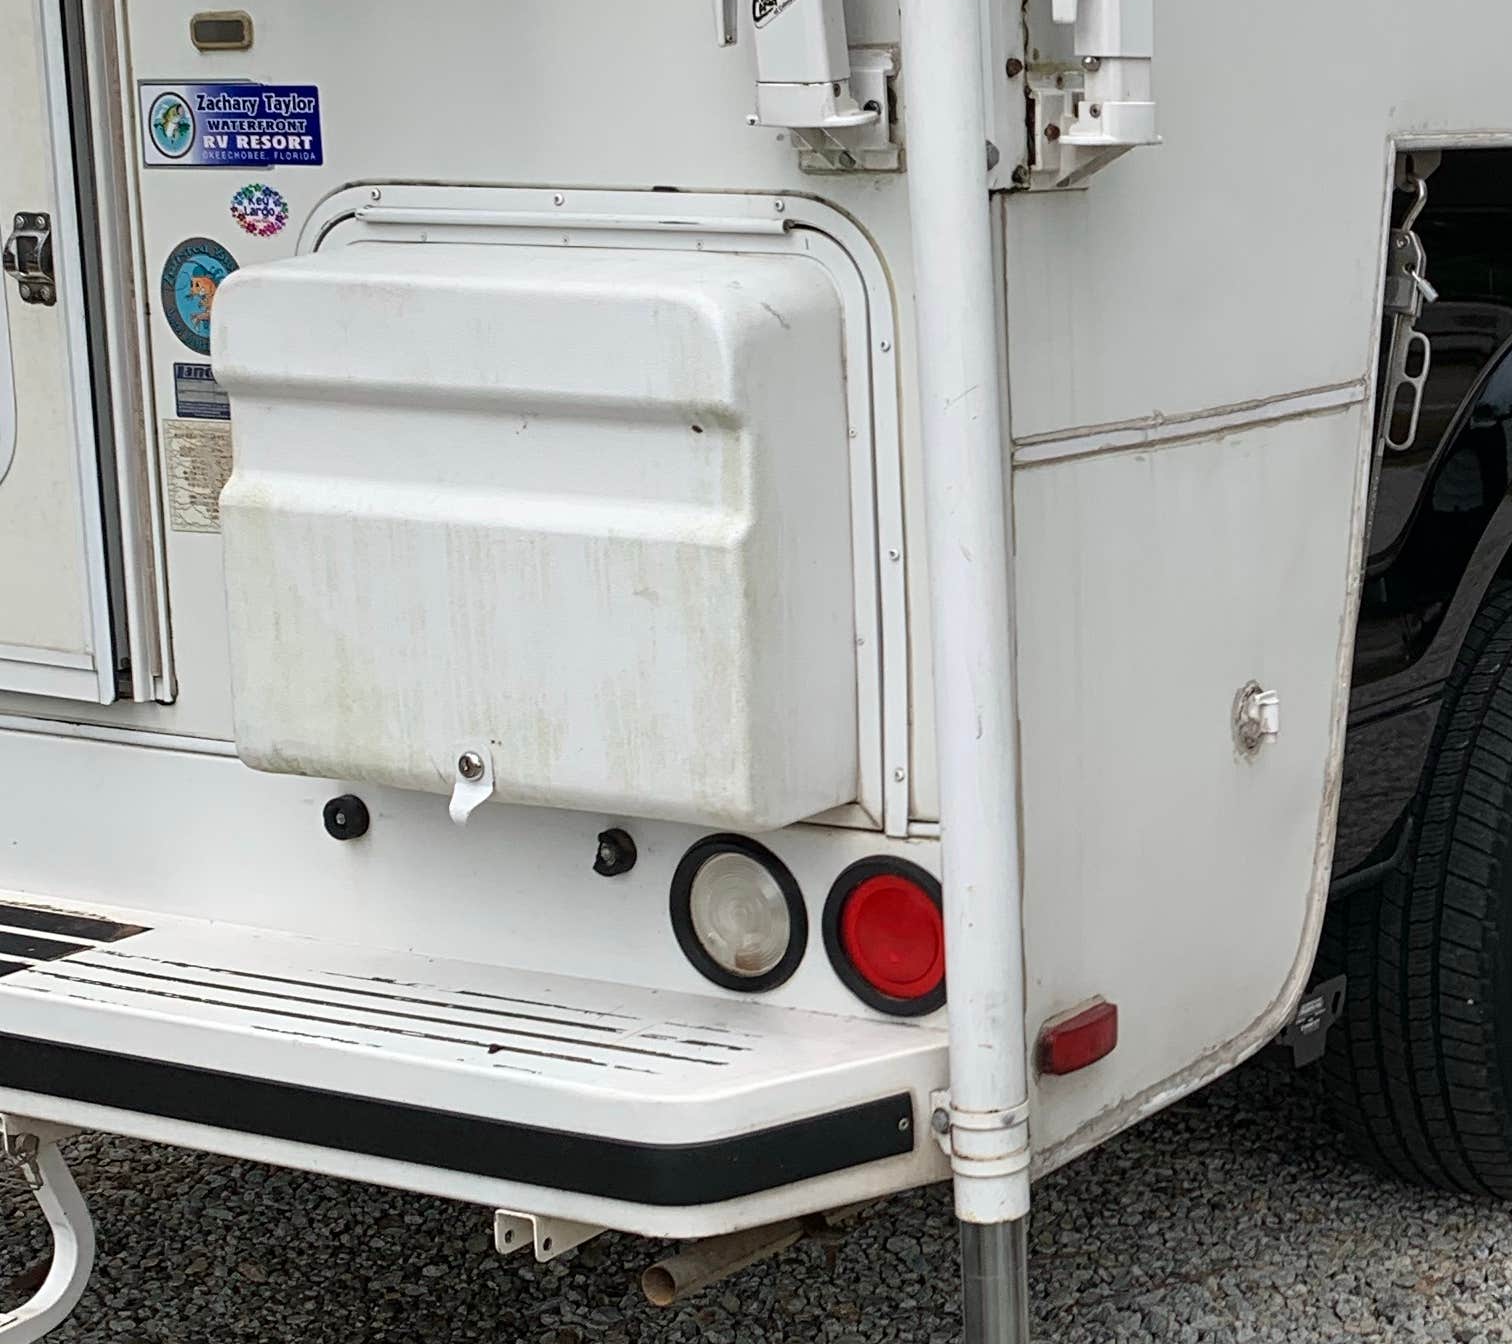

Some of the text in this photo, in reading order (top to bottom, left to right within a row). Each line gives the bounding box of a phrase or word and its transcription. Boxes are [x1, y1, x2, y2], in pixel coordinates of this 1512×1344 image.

[197, 93, 314, 115] Zachary Taylor
[207, 119, 306, 132] WATERFRONT
[202, 135, 313, 149] RV RESORT
[274, 151, 317, 161] FLORIDA
[248, 196, 269, 208] Key
[244, 206, 275, 219] Largo
